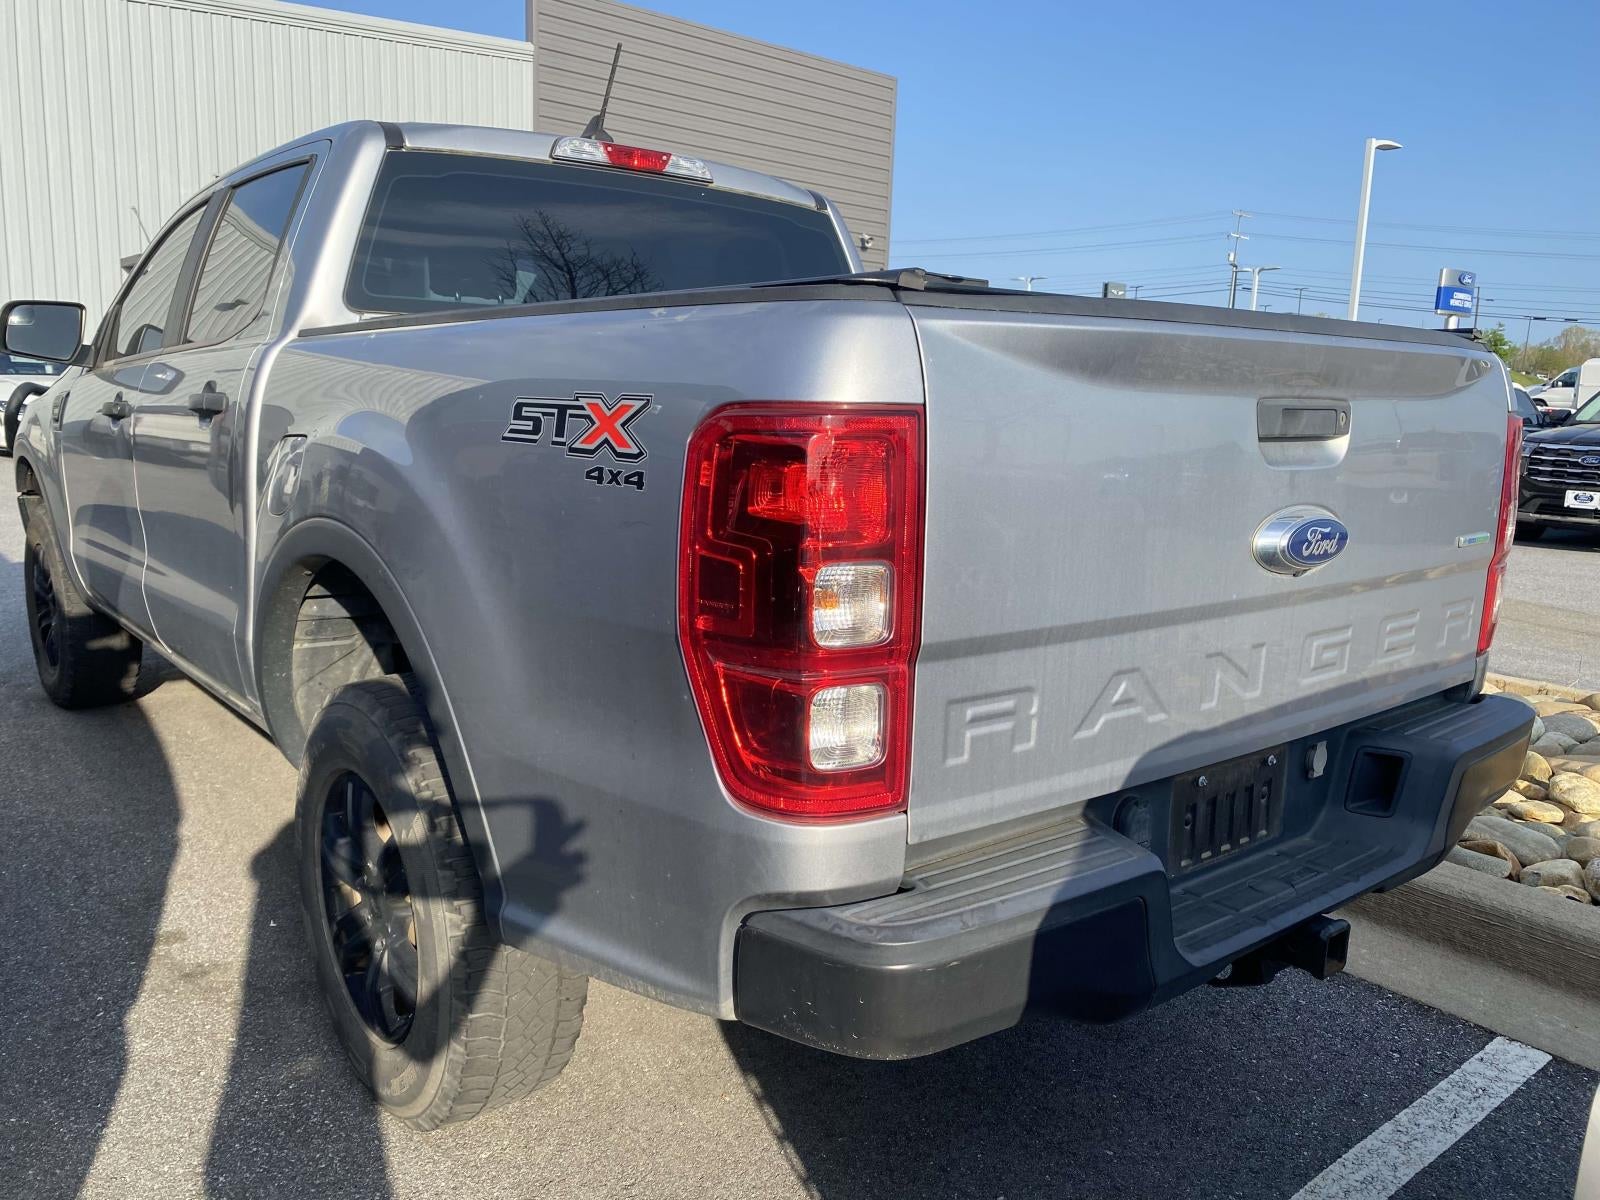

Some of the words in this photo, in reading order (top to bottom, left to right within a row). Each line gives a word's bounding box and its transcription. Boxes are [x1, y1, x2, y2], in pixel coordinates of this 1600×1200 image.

[501, 391, 654, 465] STX
[1302, 526, 1340, 557] Ford
[943, 601, 1475, 767] RANGER
